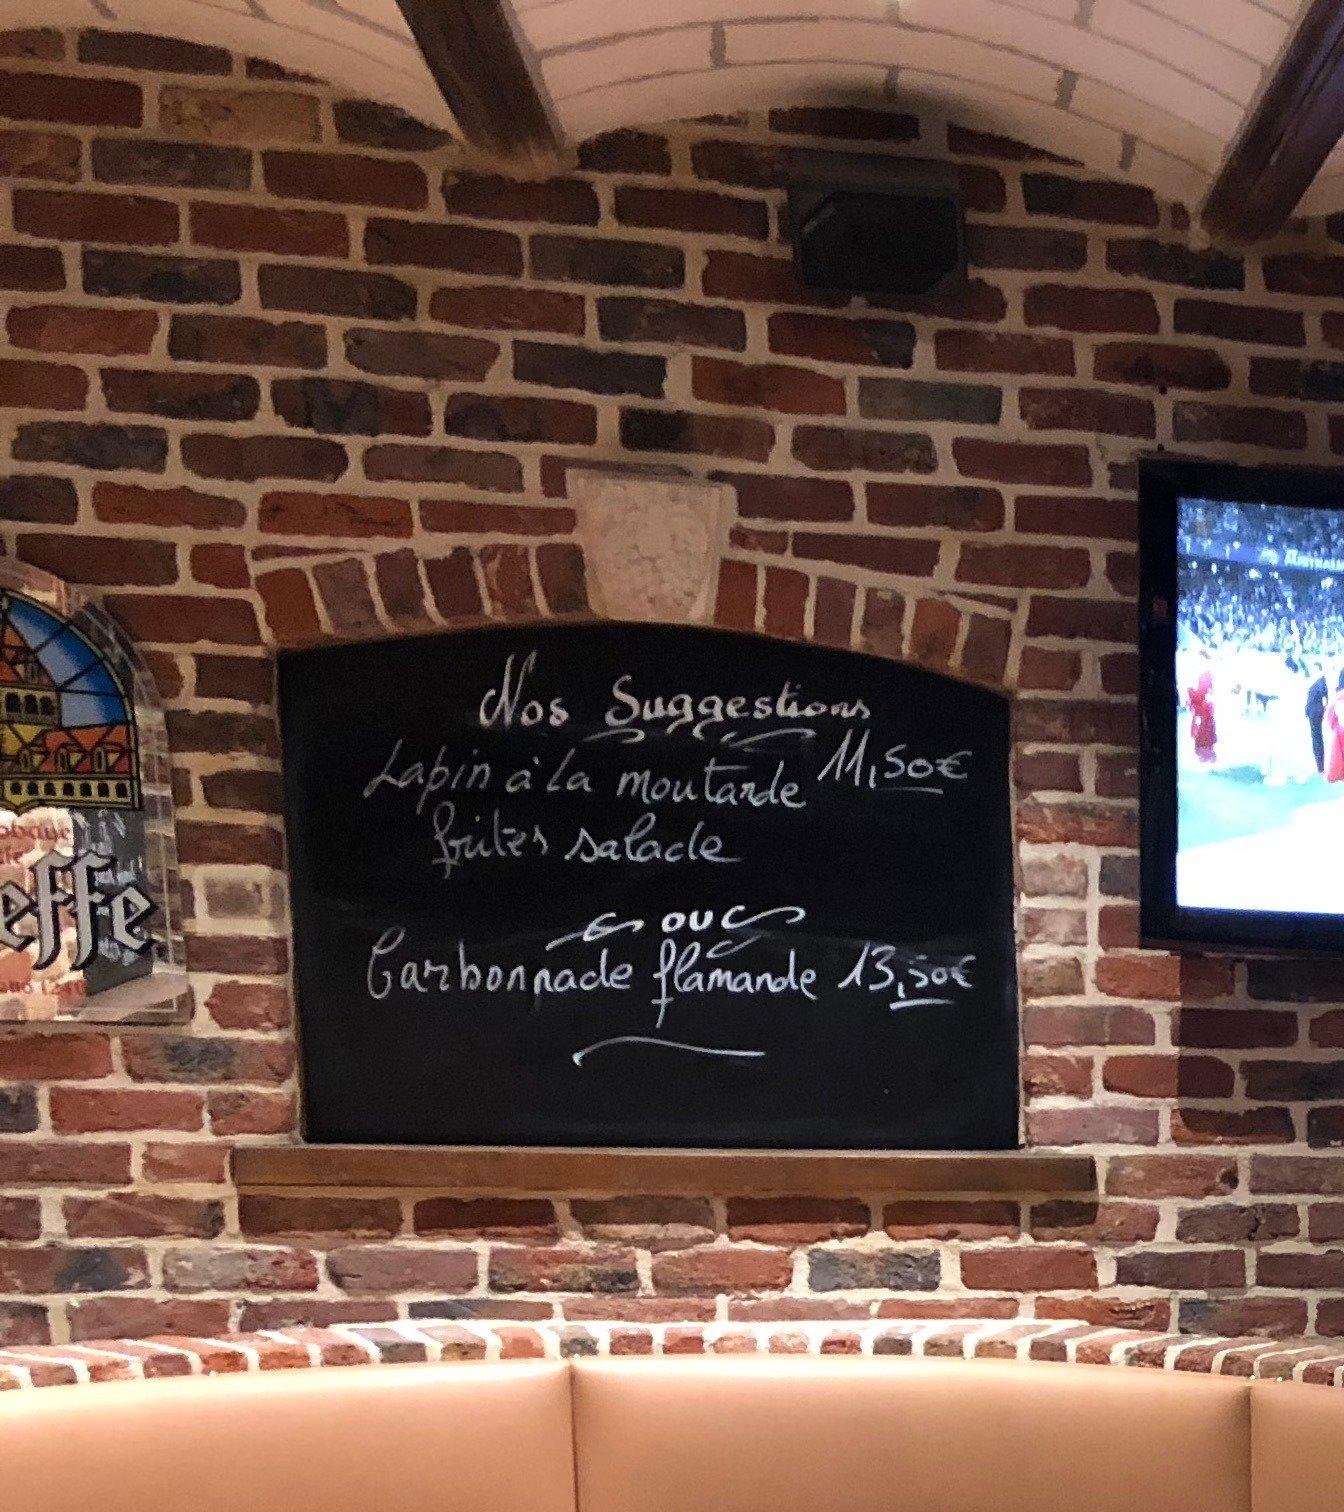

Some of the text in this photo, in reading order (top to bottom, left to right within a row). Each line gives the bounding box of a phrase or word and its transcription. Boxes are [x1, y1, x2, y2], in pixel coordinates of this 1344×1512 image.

[480, 651, 871, 741] Nos Suggestions
[364, 745, 490, 808] Lapin
[617, 763, 808, 809] moutarde
[564, 815, 742, 863] salade
[0, 848, 155, 971] effe
[367, 928, 633, 1000] Carbonnade
[653, 945, 818, 1029] flamande
